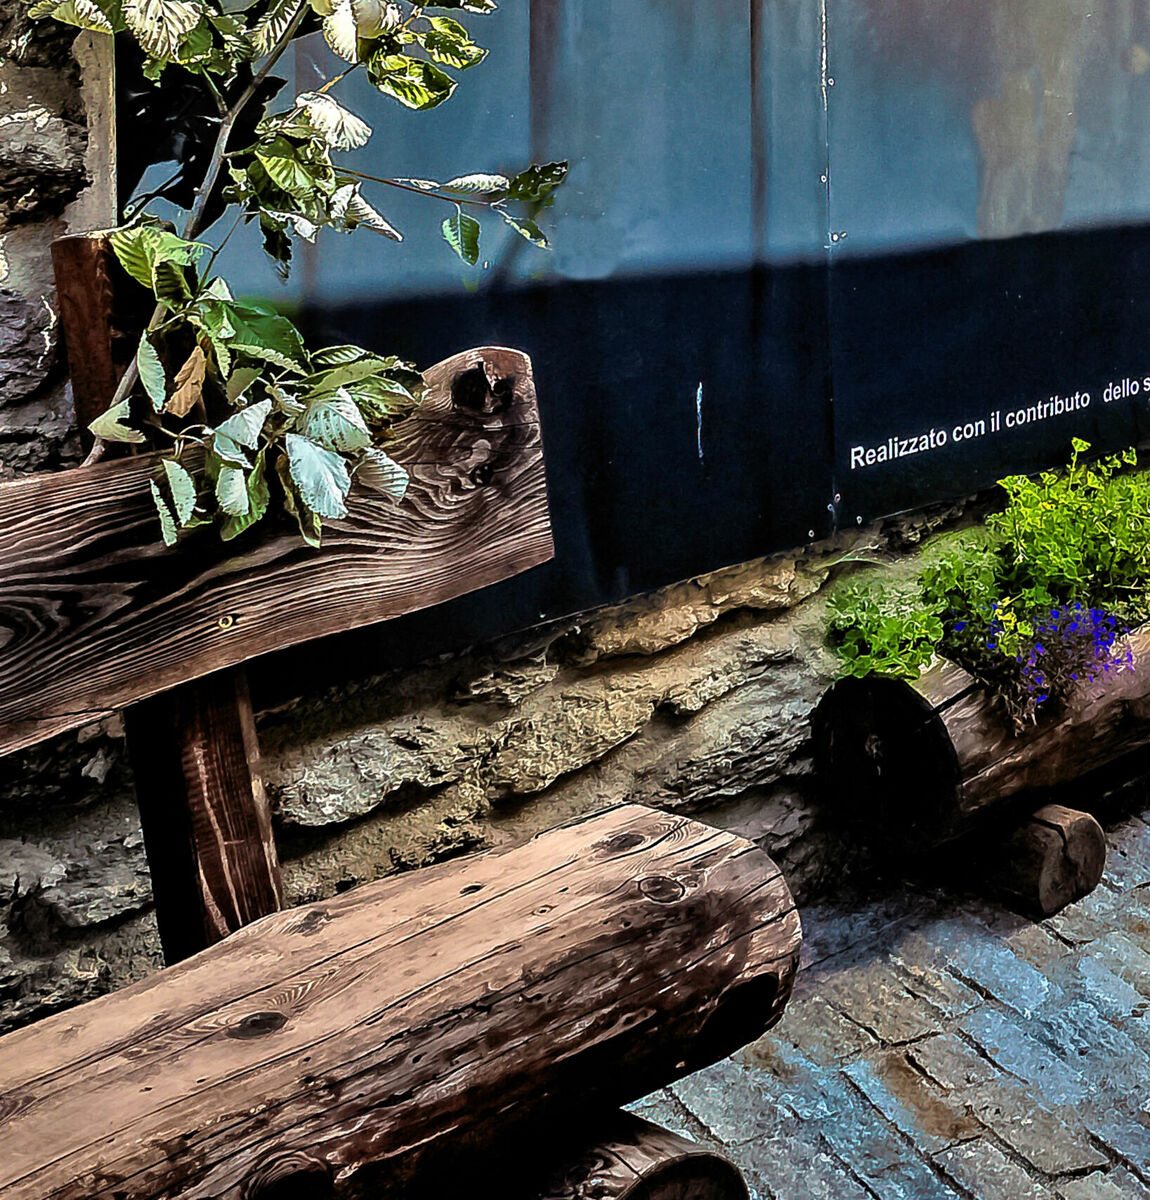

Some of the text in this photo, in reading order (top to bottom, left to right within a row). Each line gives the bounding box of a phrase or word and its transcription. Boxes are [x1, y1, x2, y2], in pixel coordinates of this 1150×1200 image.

[850, 429, 947, 469] Realizzato
[952, 419, 986, 442] con
[990, 410, 1000, 432] il
[1005, 391, 1091, 428] contributo
[1103, 378, 1140, 403] dello
